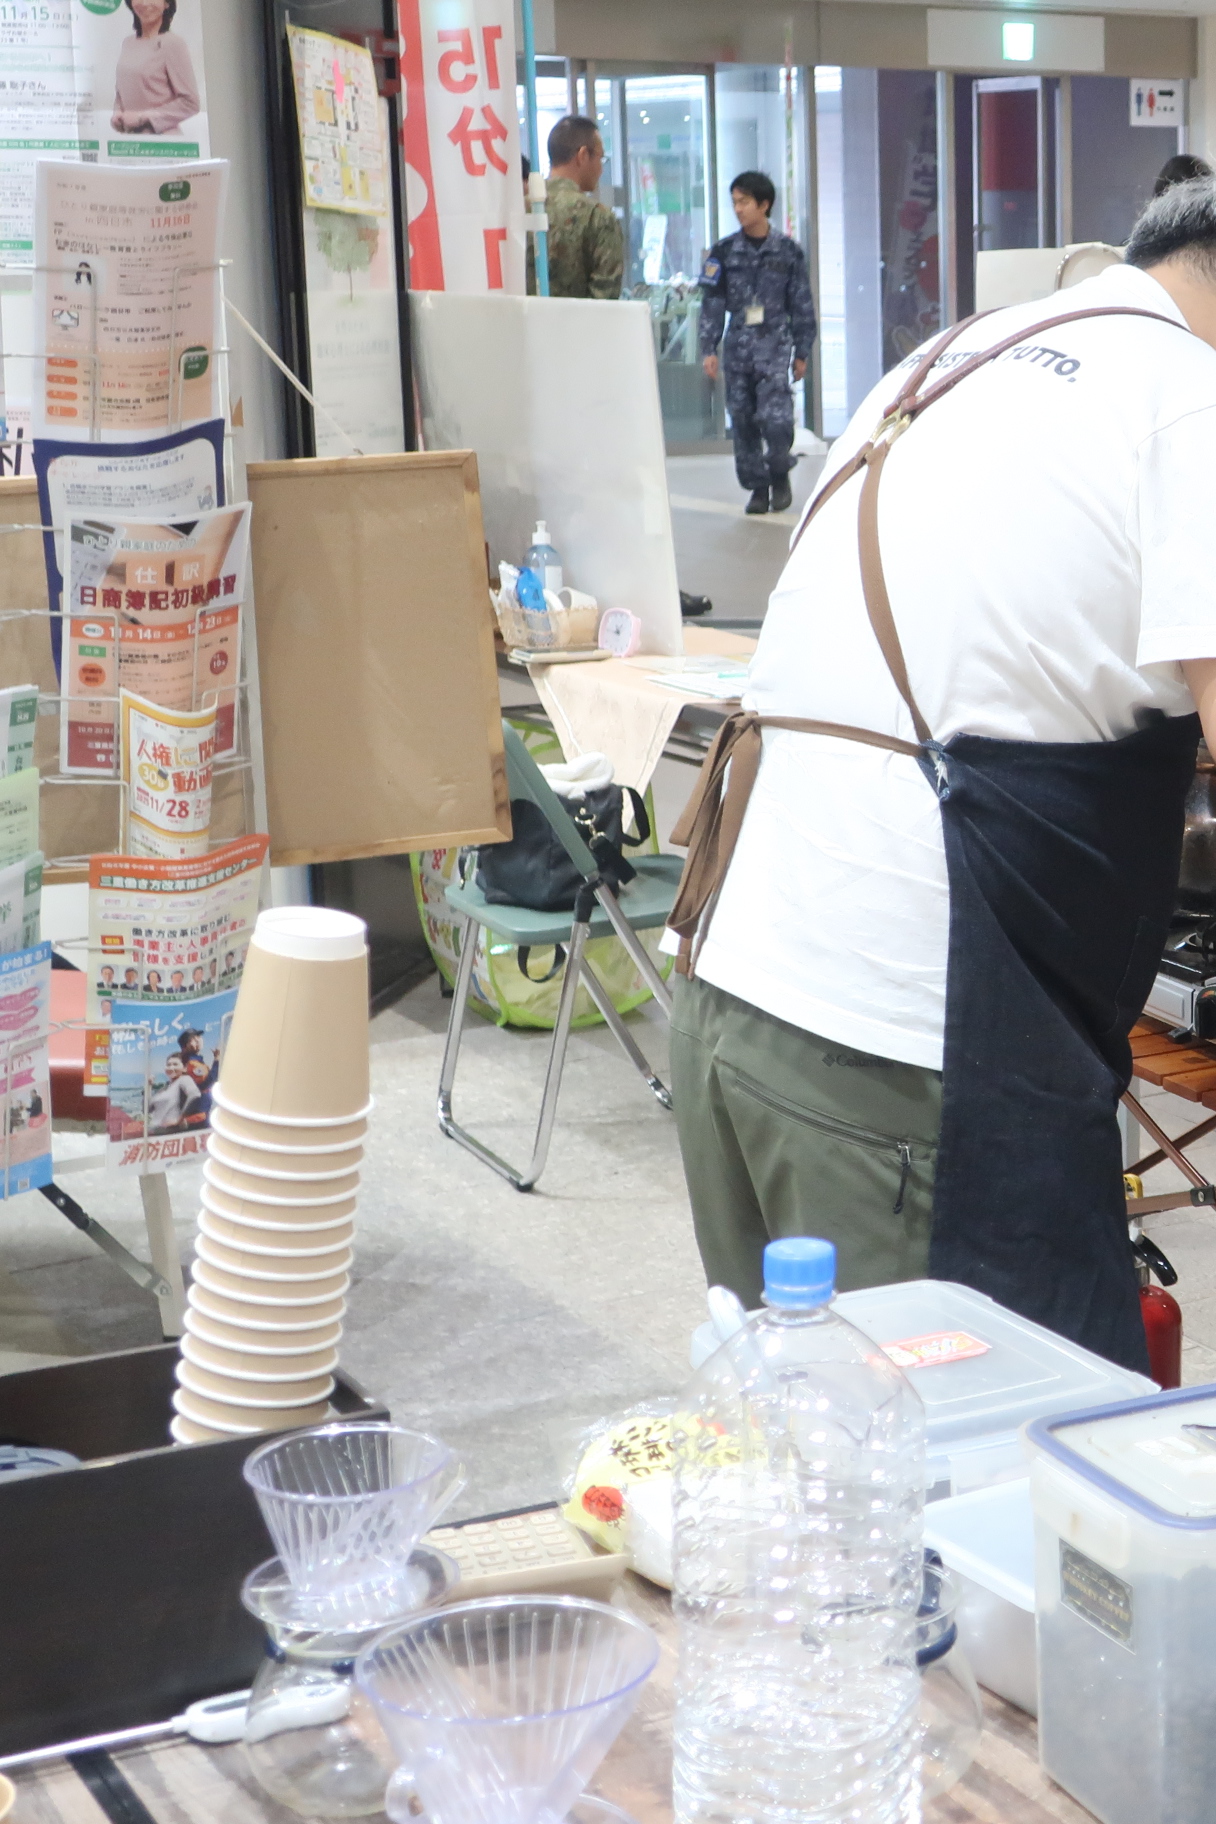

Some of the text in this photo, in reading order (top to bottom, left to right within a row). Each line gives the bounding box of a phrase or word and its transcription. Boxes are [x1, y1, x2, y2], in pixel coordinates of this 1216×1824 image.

[80, 574, 236, 610] 日商簿記初級講習
